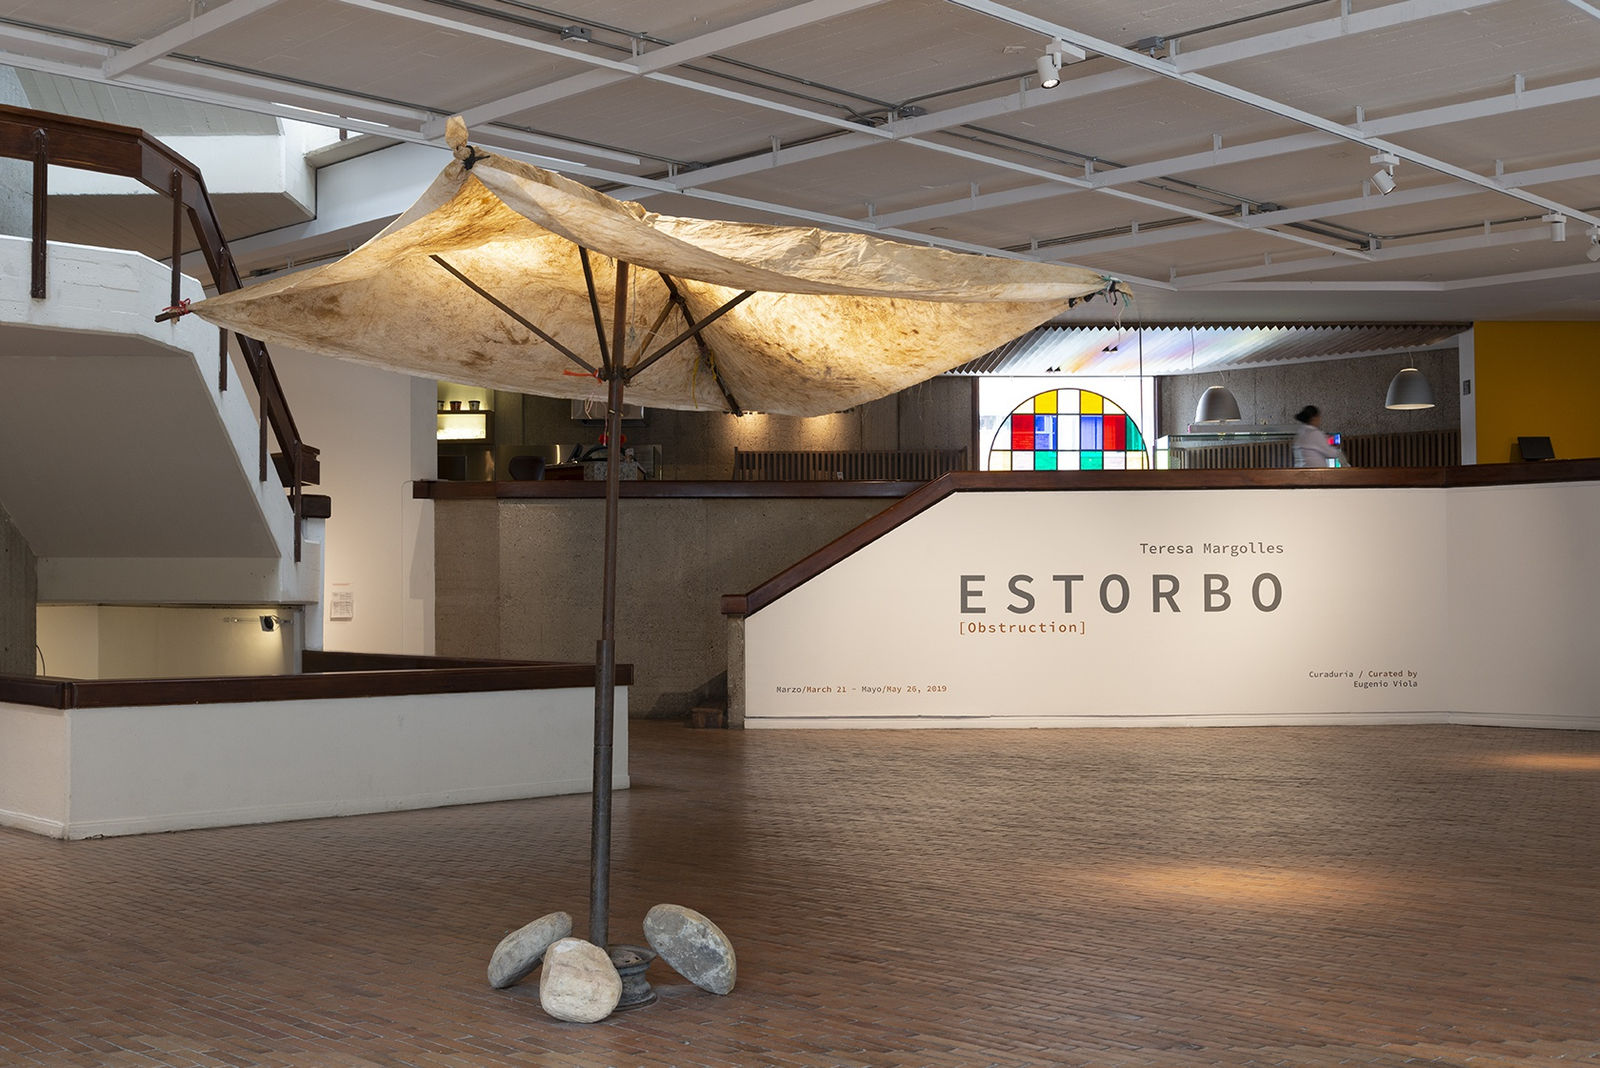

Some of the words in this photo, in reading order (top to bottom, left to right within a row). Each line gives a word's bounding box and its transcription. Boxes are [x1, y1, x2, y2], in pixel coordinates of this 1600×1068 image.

[1140, 543, 1194, 555] Teresa
[1204, 542, 1284, 557] Margolles
[961, 573, 1283, 614] ESTORBO
[959, 621, 1085, 636] [Obstruction]
[1367, 669, 1404, 679] Curated
[1407, 669, 1418, 680] by
[776, 685, 833, 696] Marzo/March
[836, 685, 847, 695] 21
[861, 685, 902, 697] Mayo/May
[906, 685, 921, 696] 26,
[926, 684, 948, 694] 2019
[1353, 680, 1389, 690] Eugenio
[1392, 679, 1418, 689] Viola
